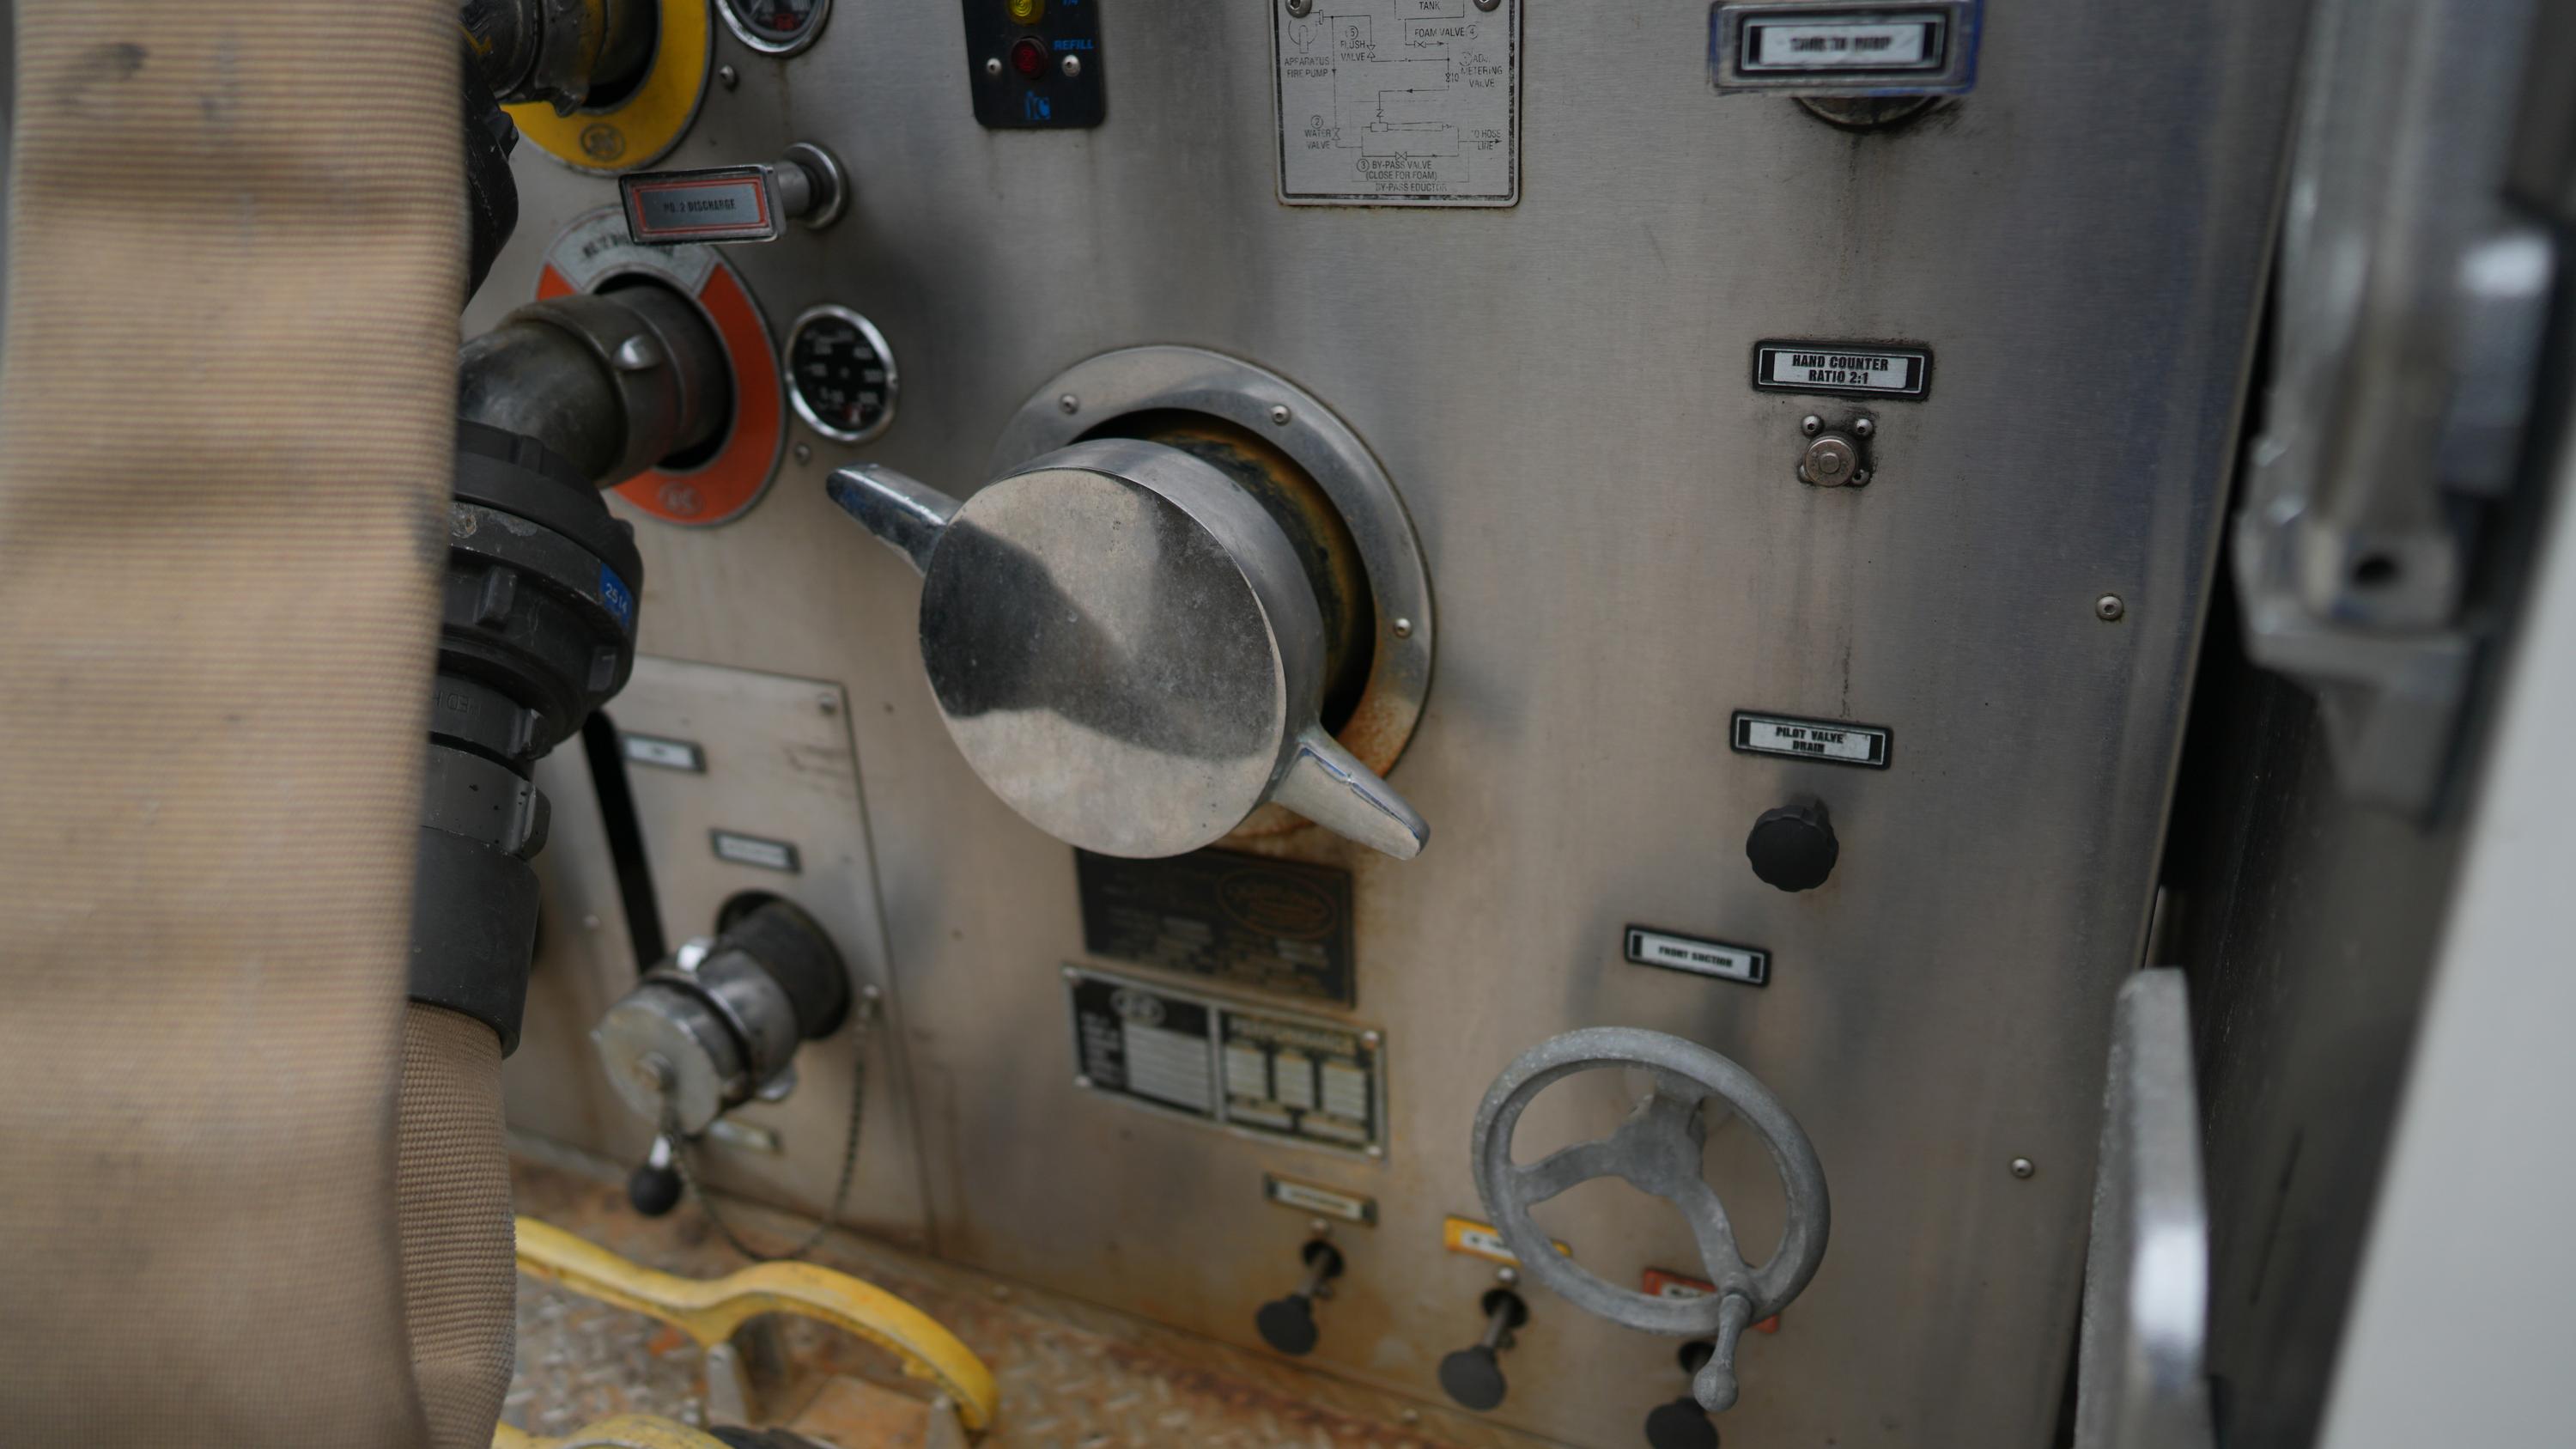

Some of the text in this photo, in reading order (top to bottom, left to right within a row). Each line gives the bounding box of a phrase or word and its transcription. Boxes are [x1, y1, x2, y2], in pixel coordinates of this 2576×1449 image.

[1419, 1, 1441, 10] TANK
[1414, 28, 1437, 38] FOAM
[1442, 27, 1465, 37] VALVE
[1054, 39, 1093, 51] REFILL
[1340, 40, 1365, 49] FLUSH
[1284, 56, 1330, 66] APPARATUS
[1340, 52, 1365, 61] VALVE
[1286, 68, 1328, 78] FIRE PUMP
[1461, 66, 1503, 76] METERING
[1469, 78, 1495, 88] VALVE
[1481, 130, 1501, 138] HOSE
[1307, 141, 1331, 149] VALVE
[1372, 161, 1406, 170] BY-PASS
[1407, 161, 1432, 169] VALVE
[1366, 171, 1437, 181] (CLOSE FOR FOAM)
[1376, 183, 1409, 192] BY-PASS
[688, 198, 736, 212] DISCHARGE
[1792, 355, 1889, 371] HAND COUNTER
[1808, 369, 1869, 385] RATIO 2:1
[1776, 726, 1844, 744] PILOT VALVE
[1792, 740, 1825, 753] DRAIN
[1659, 946, 1733, 968] FRONT SUCTION
